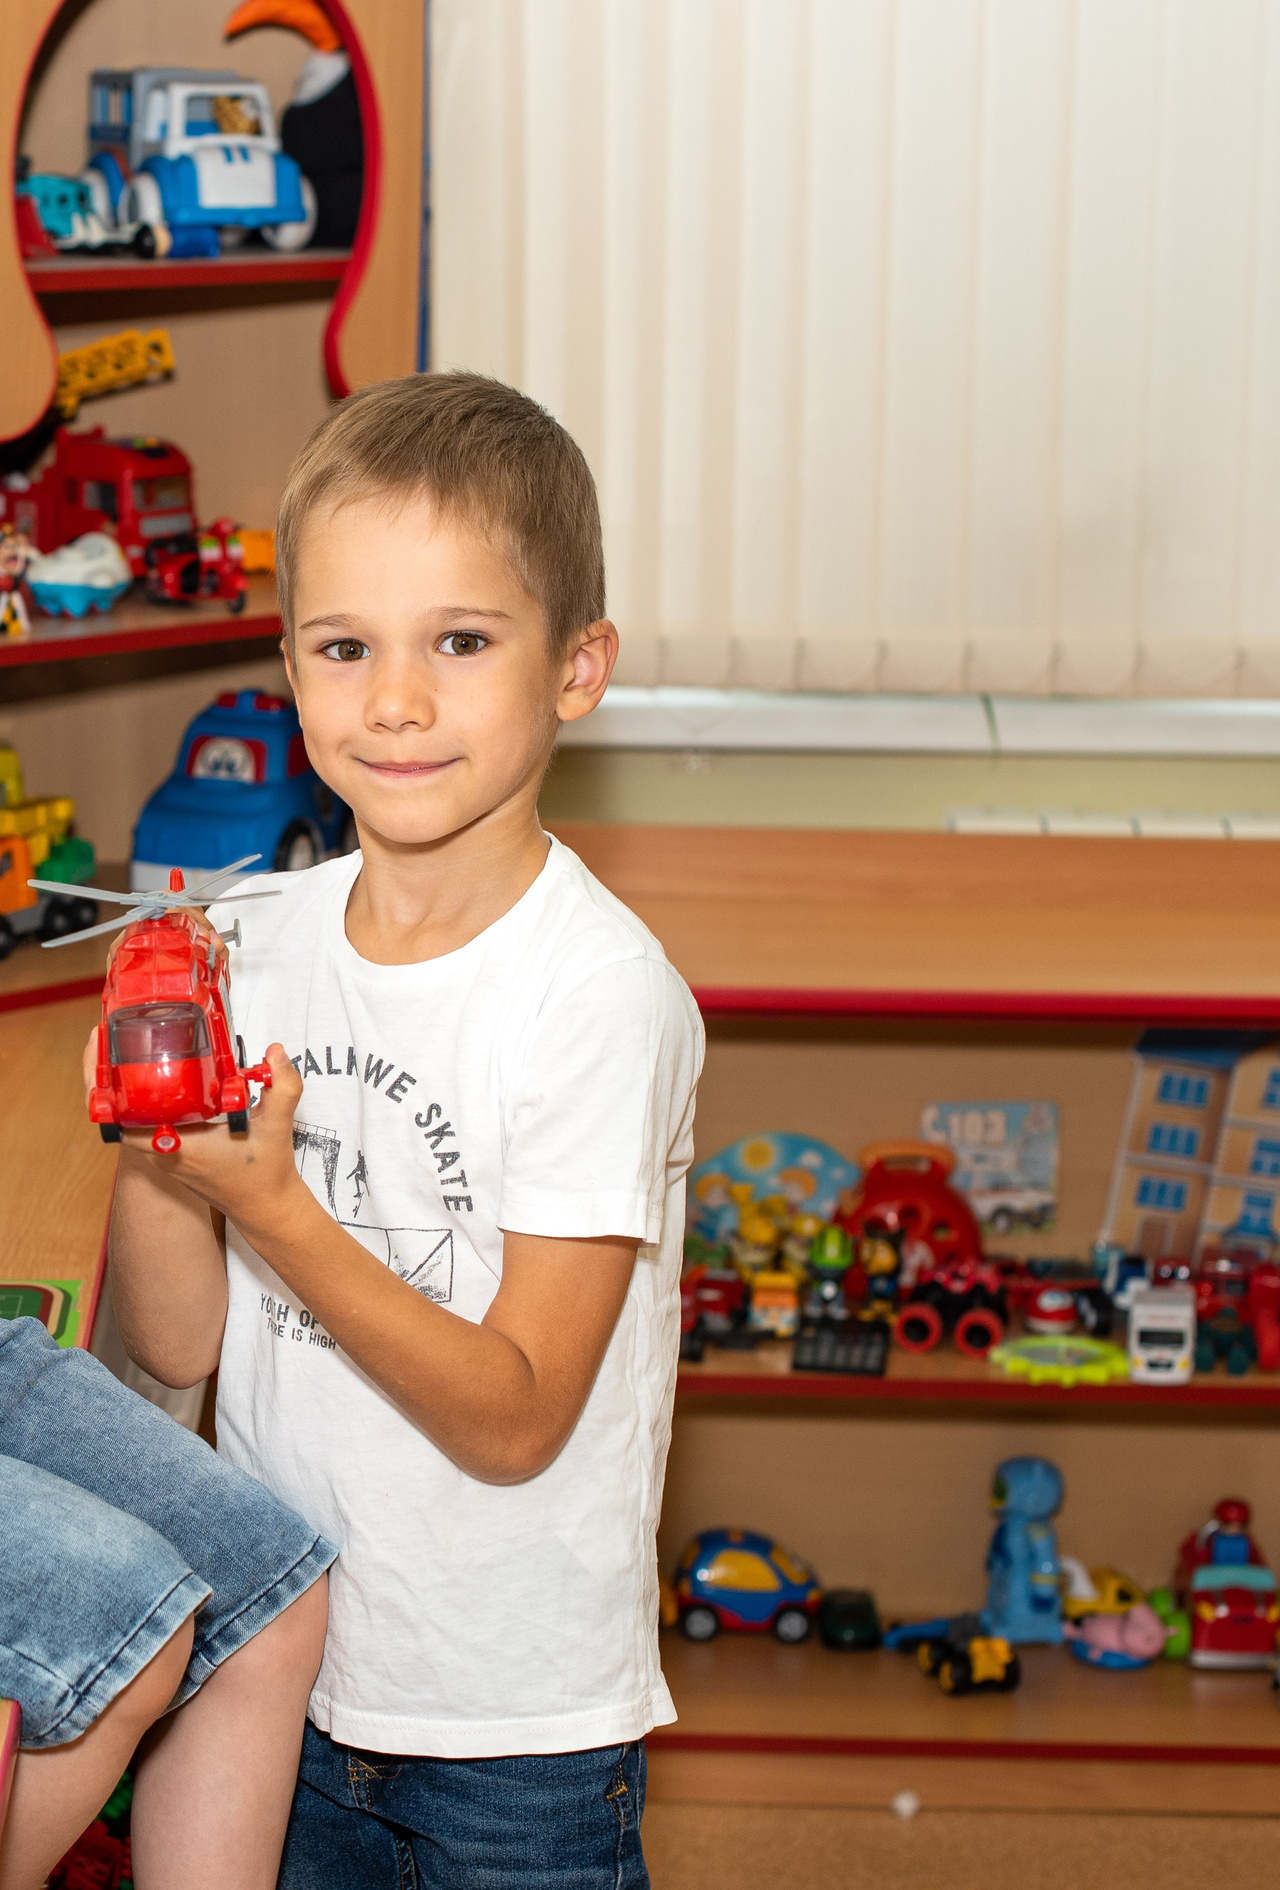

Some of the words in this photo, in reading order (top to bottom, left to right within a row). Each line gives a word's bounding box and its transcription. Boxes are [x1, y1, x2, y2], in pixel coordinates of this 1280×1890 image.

[364, 1053, 417, 1104] WE
[414, 1103, 474, 1212] SKATE
[291, 1327, 304, 1342] IS
[308, 1331, 337, 1351] HIGH
